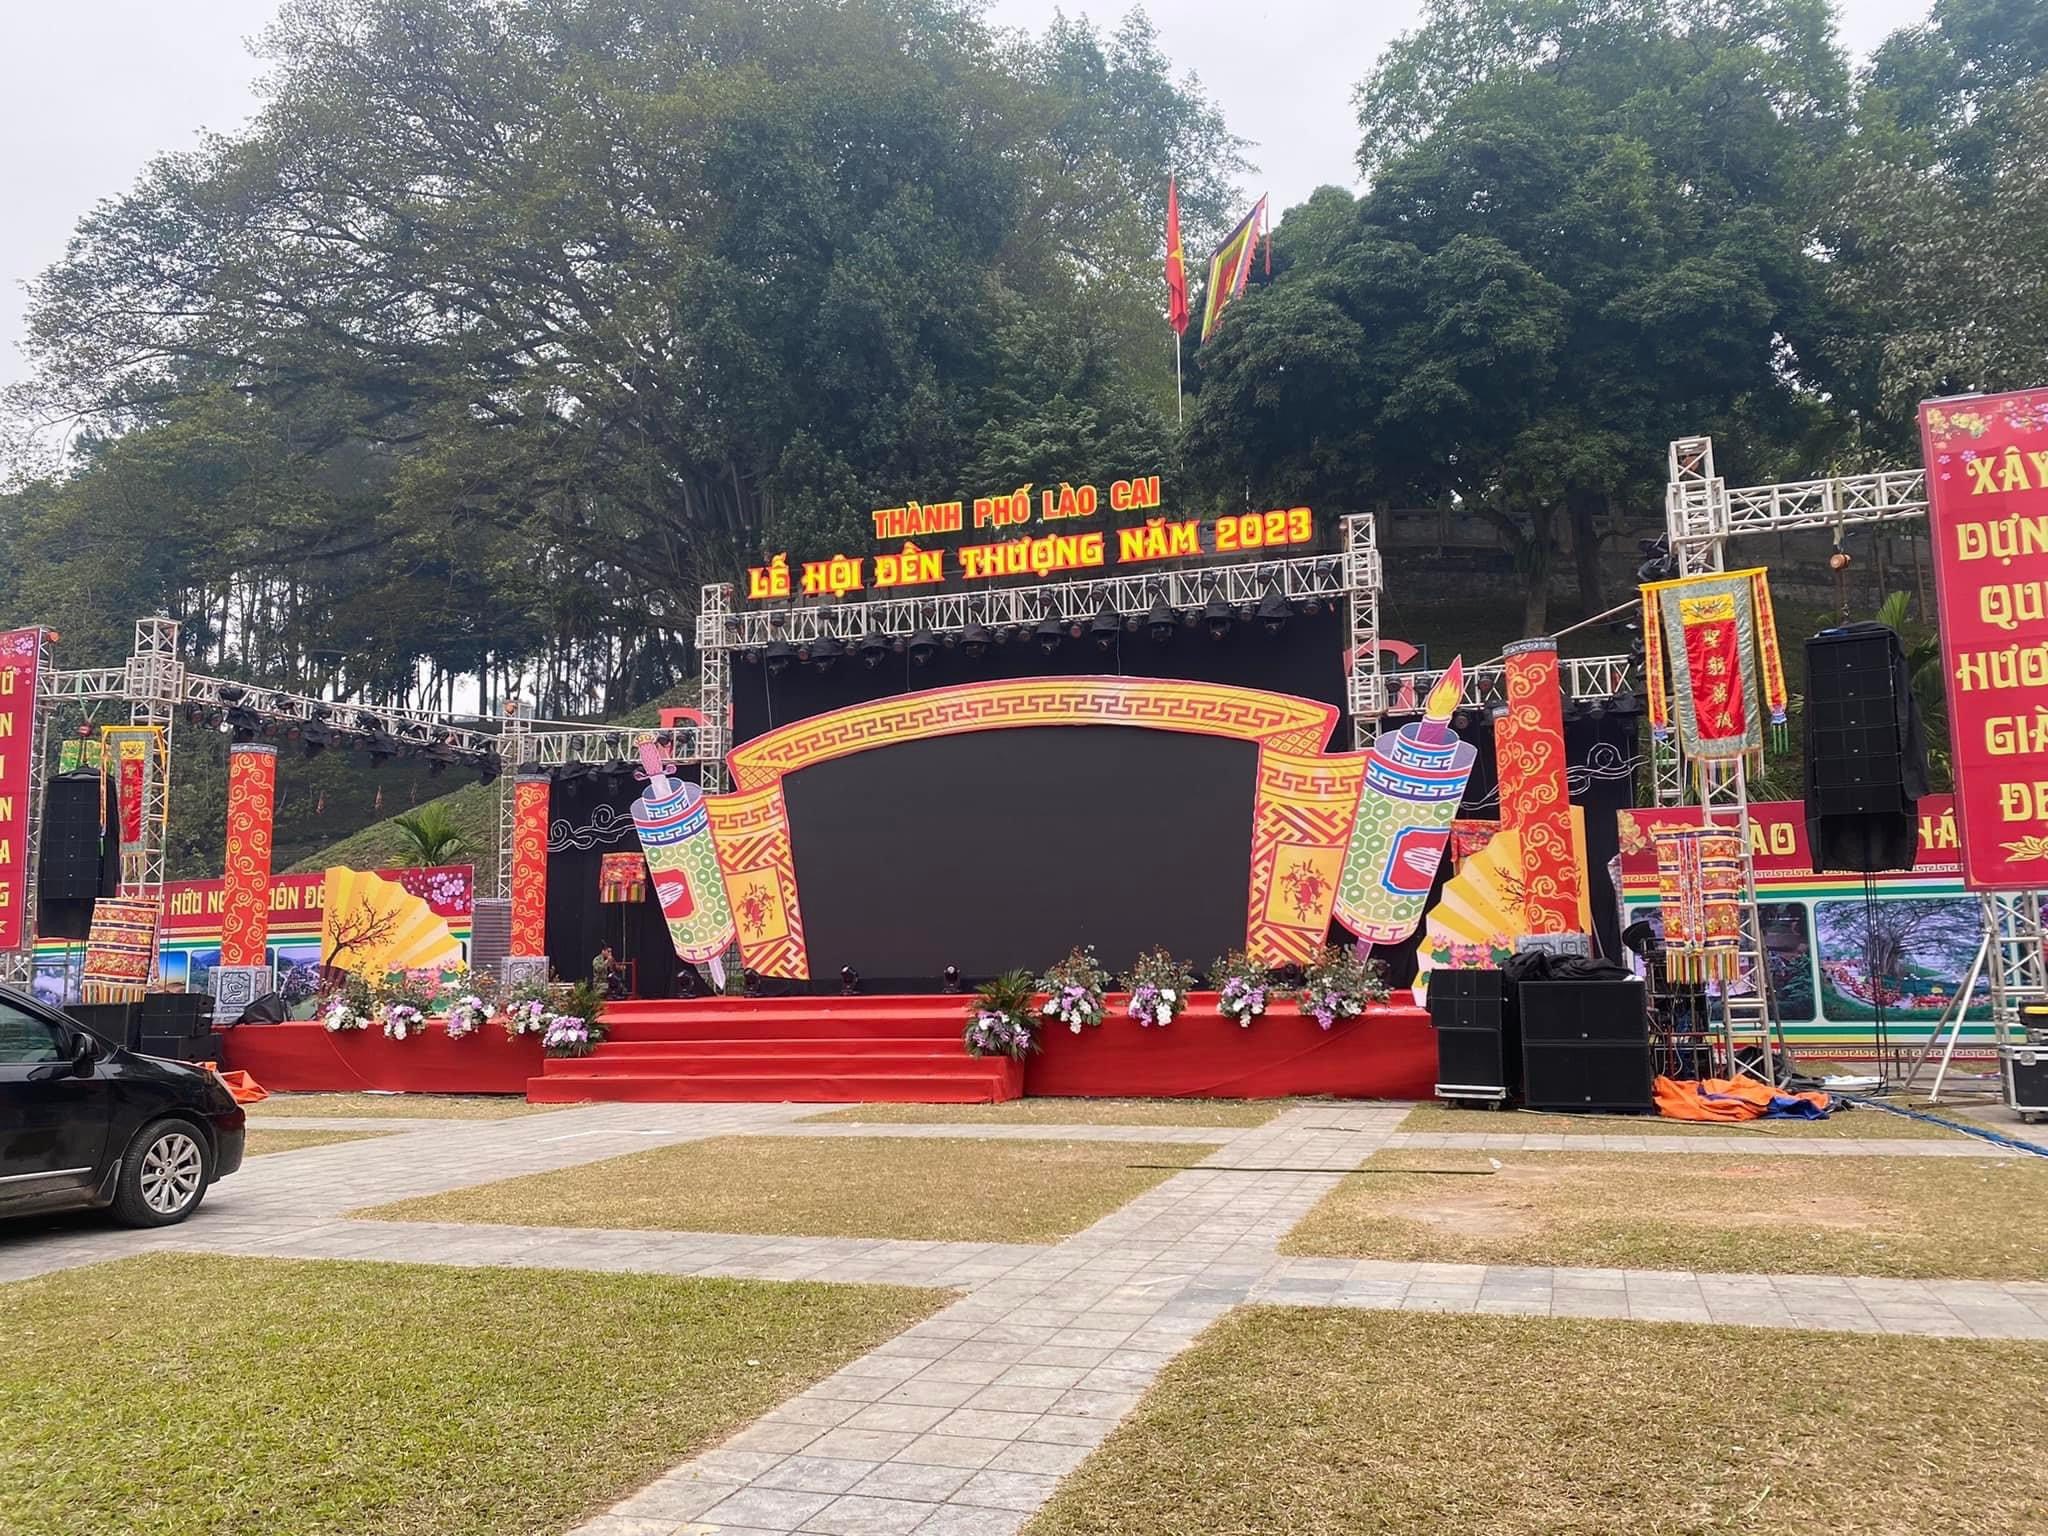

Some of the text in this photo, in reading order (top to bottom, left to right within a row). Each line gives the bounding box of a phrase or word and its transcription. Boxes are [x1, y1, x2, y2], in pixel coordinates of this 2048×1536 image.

[872, 475, 1160, 539] THÀNH PHỐ LÀO CAI
[801, 554, 864, 598] HỘI
[873, 541, 945, 588] ĐỀN
[959, 532, 1105, 579] THƯỢNG
[1116, 517, 1204, 563] NĂM
[1215, 507, 1313, 552] 2023
[1979, 580, 2048, 630] QU
[1749, 816, 1796, 856] ÀO
